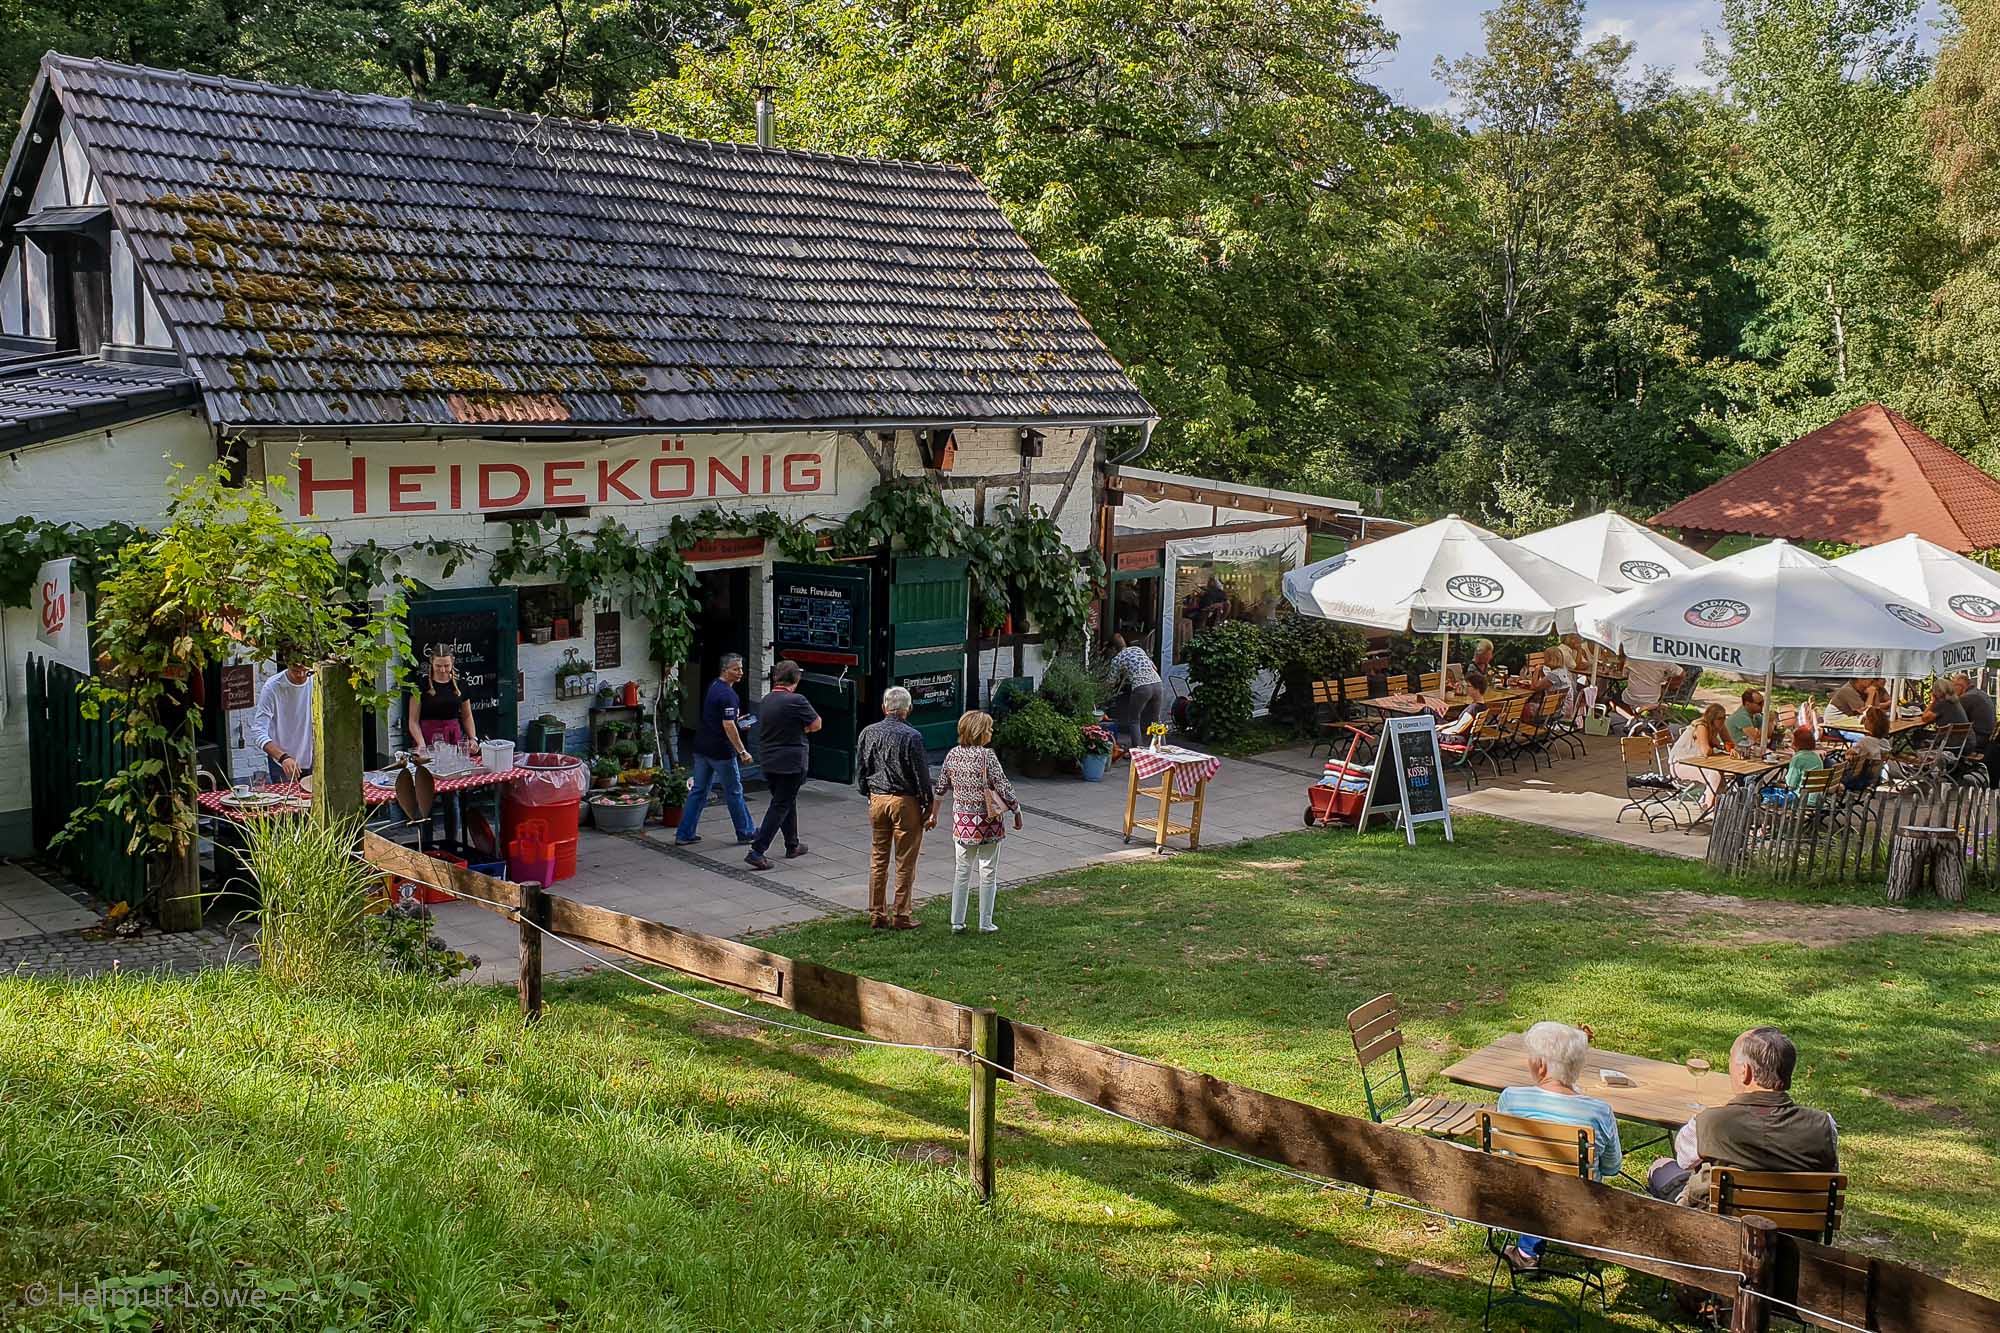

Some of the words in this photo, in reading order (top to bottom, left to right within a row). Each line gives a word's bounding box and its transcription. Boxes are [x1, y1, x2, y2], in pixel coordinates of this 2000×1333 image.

[299, 439, 822, 516] HEIDEKÖNIG
[42, 577, 66, 628] Eis
[1438, 610, 1523, 629] ERDINGER
[1652, 636, 1743, 667] ERDINGER
[1820, 650, 1881, 670] Weißbier
[1942, 646, 1976, 668] RDINGER
[1411, 776, 1430, 788] FELLE
